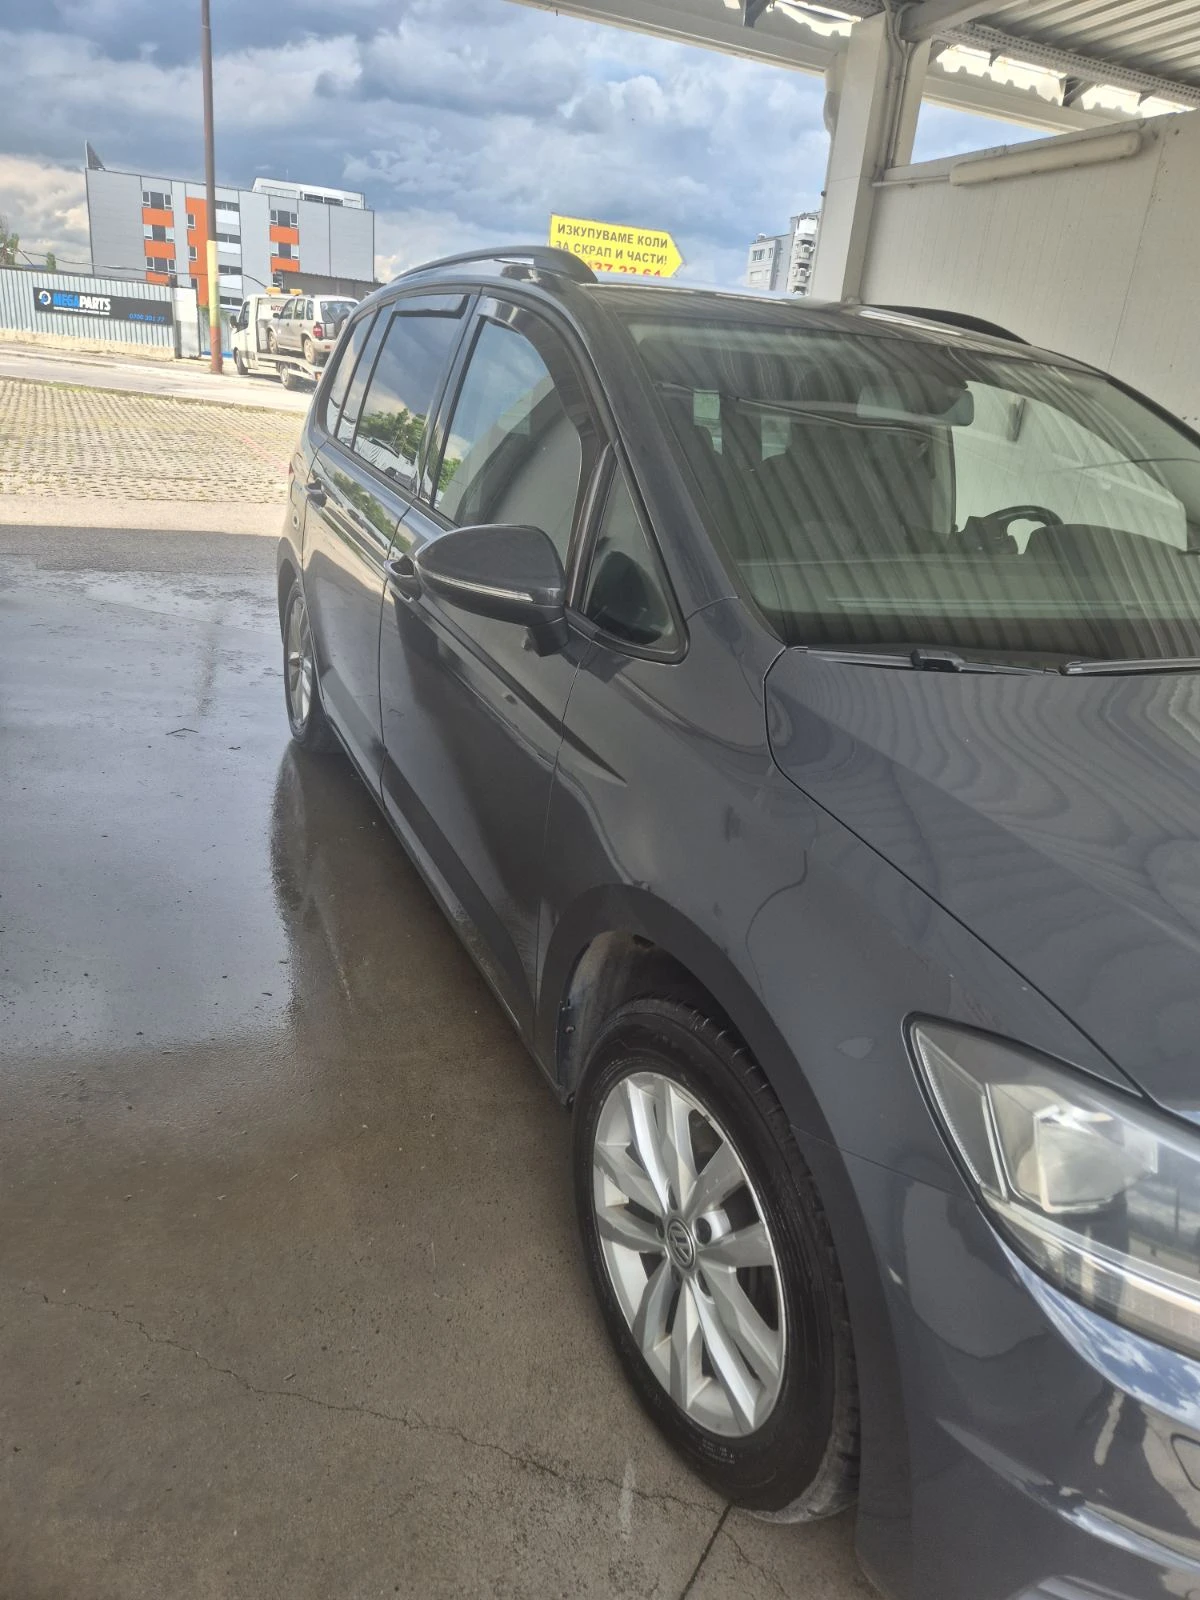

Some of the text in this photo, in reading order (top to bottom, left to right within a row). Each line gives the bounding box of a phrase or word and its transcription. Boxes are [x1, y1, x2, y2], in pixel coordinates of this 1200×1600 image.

[557, 223, 668, 248] ИЗКУПУВАМЕ КОЛИ
[555, 240, 668, 265] ЗА СКРАП И ЧАСТИ!
